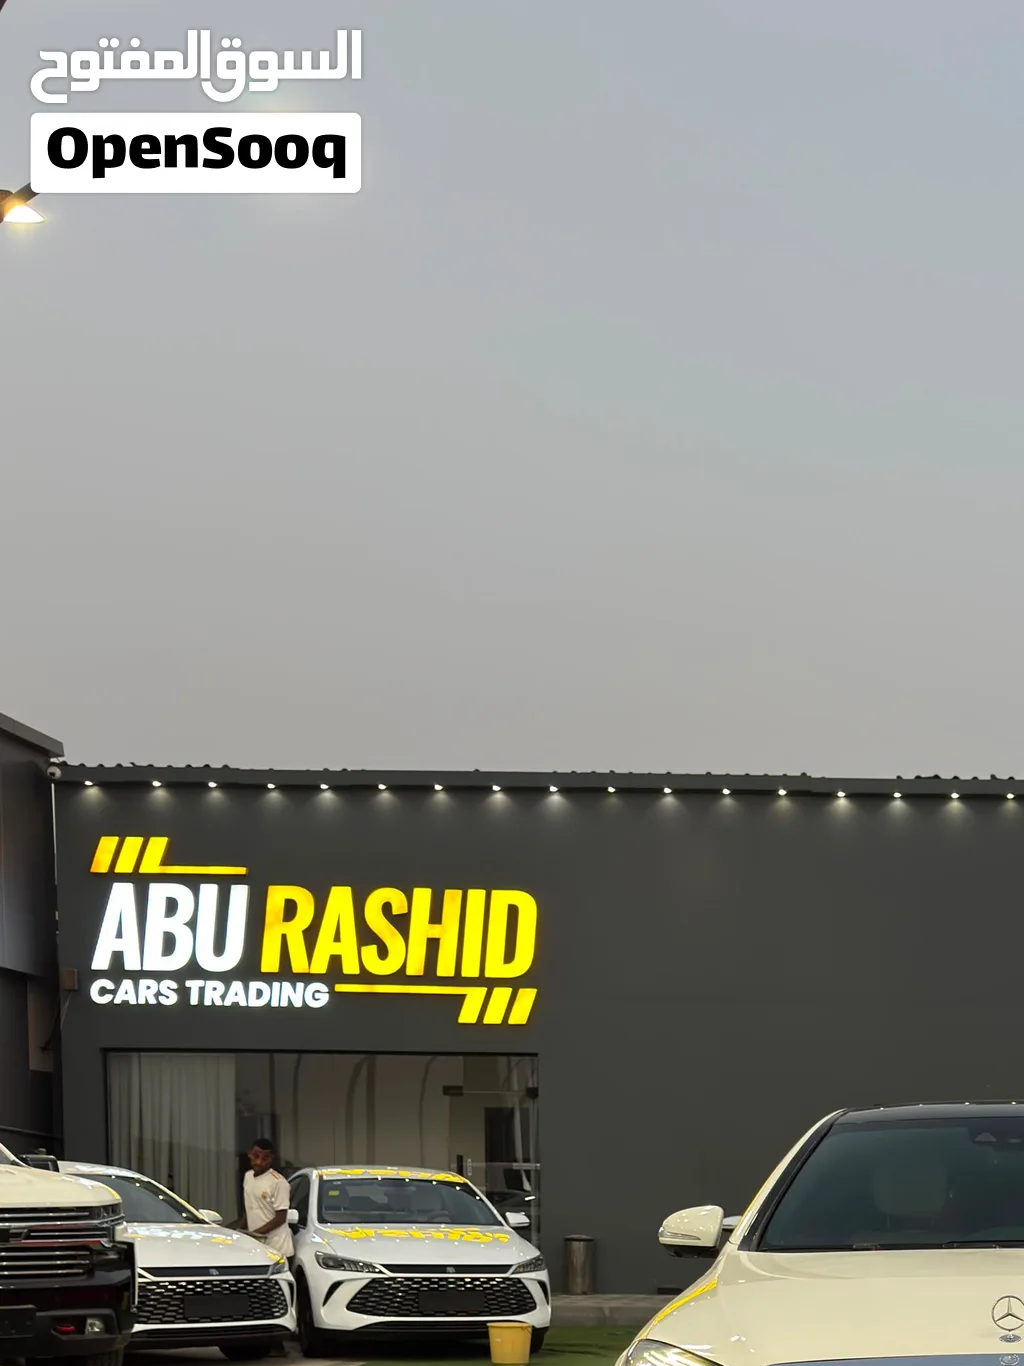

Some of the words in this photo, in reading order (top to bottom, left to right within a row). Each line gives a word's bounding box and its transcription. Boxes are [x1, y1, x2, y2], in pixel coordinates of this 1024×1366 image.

[90, 882, 249, 972] ABU
[260, 884, 538, 979] RASHID
[89, 978, 178, 1006] CARS
[185, 979, 330, 1009] TRADING
